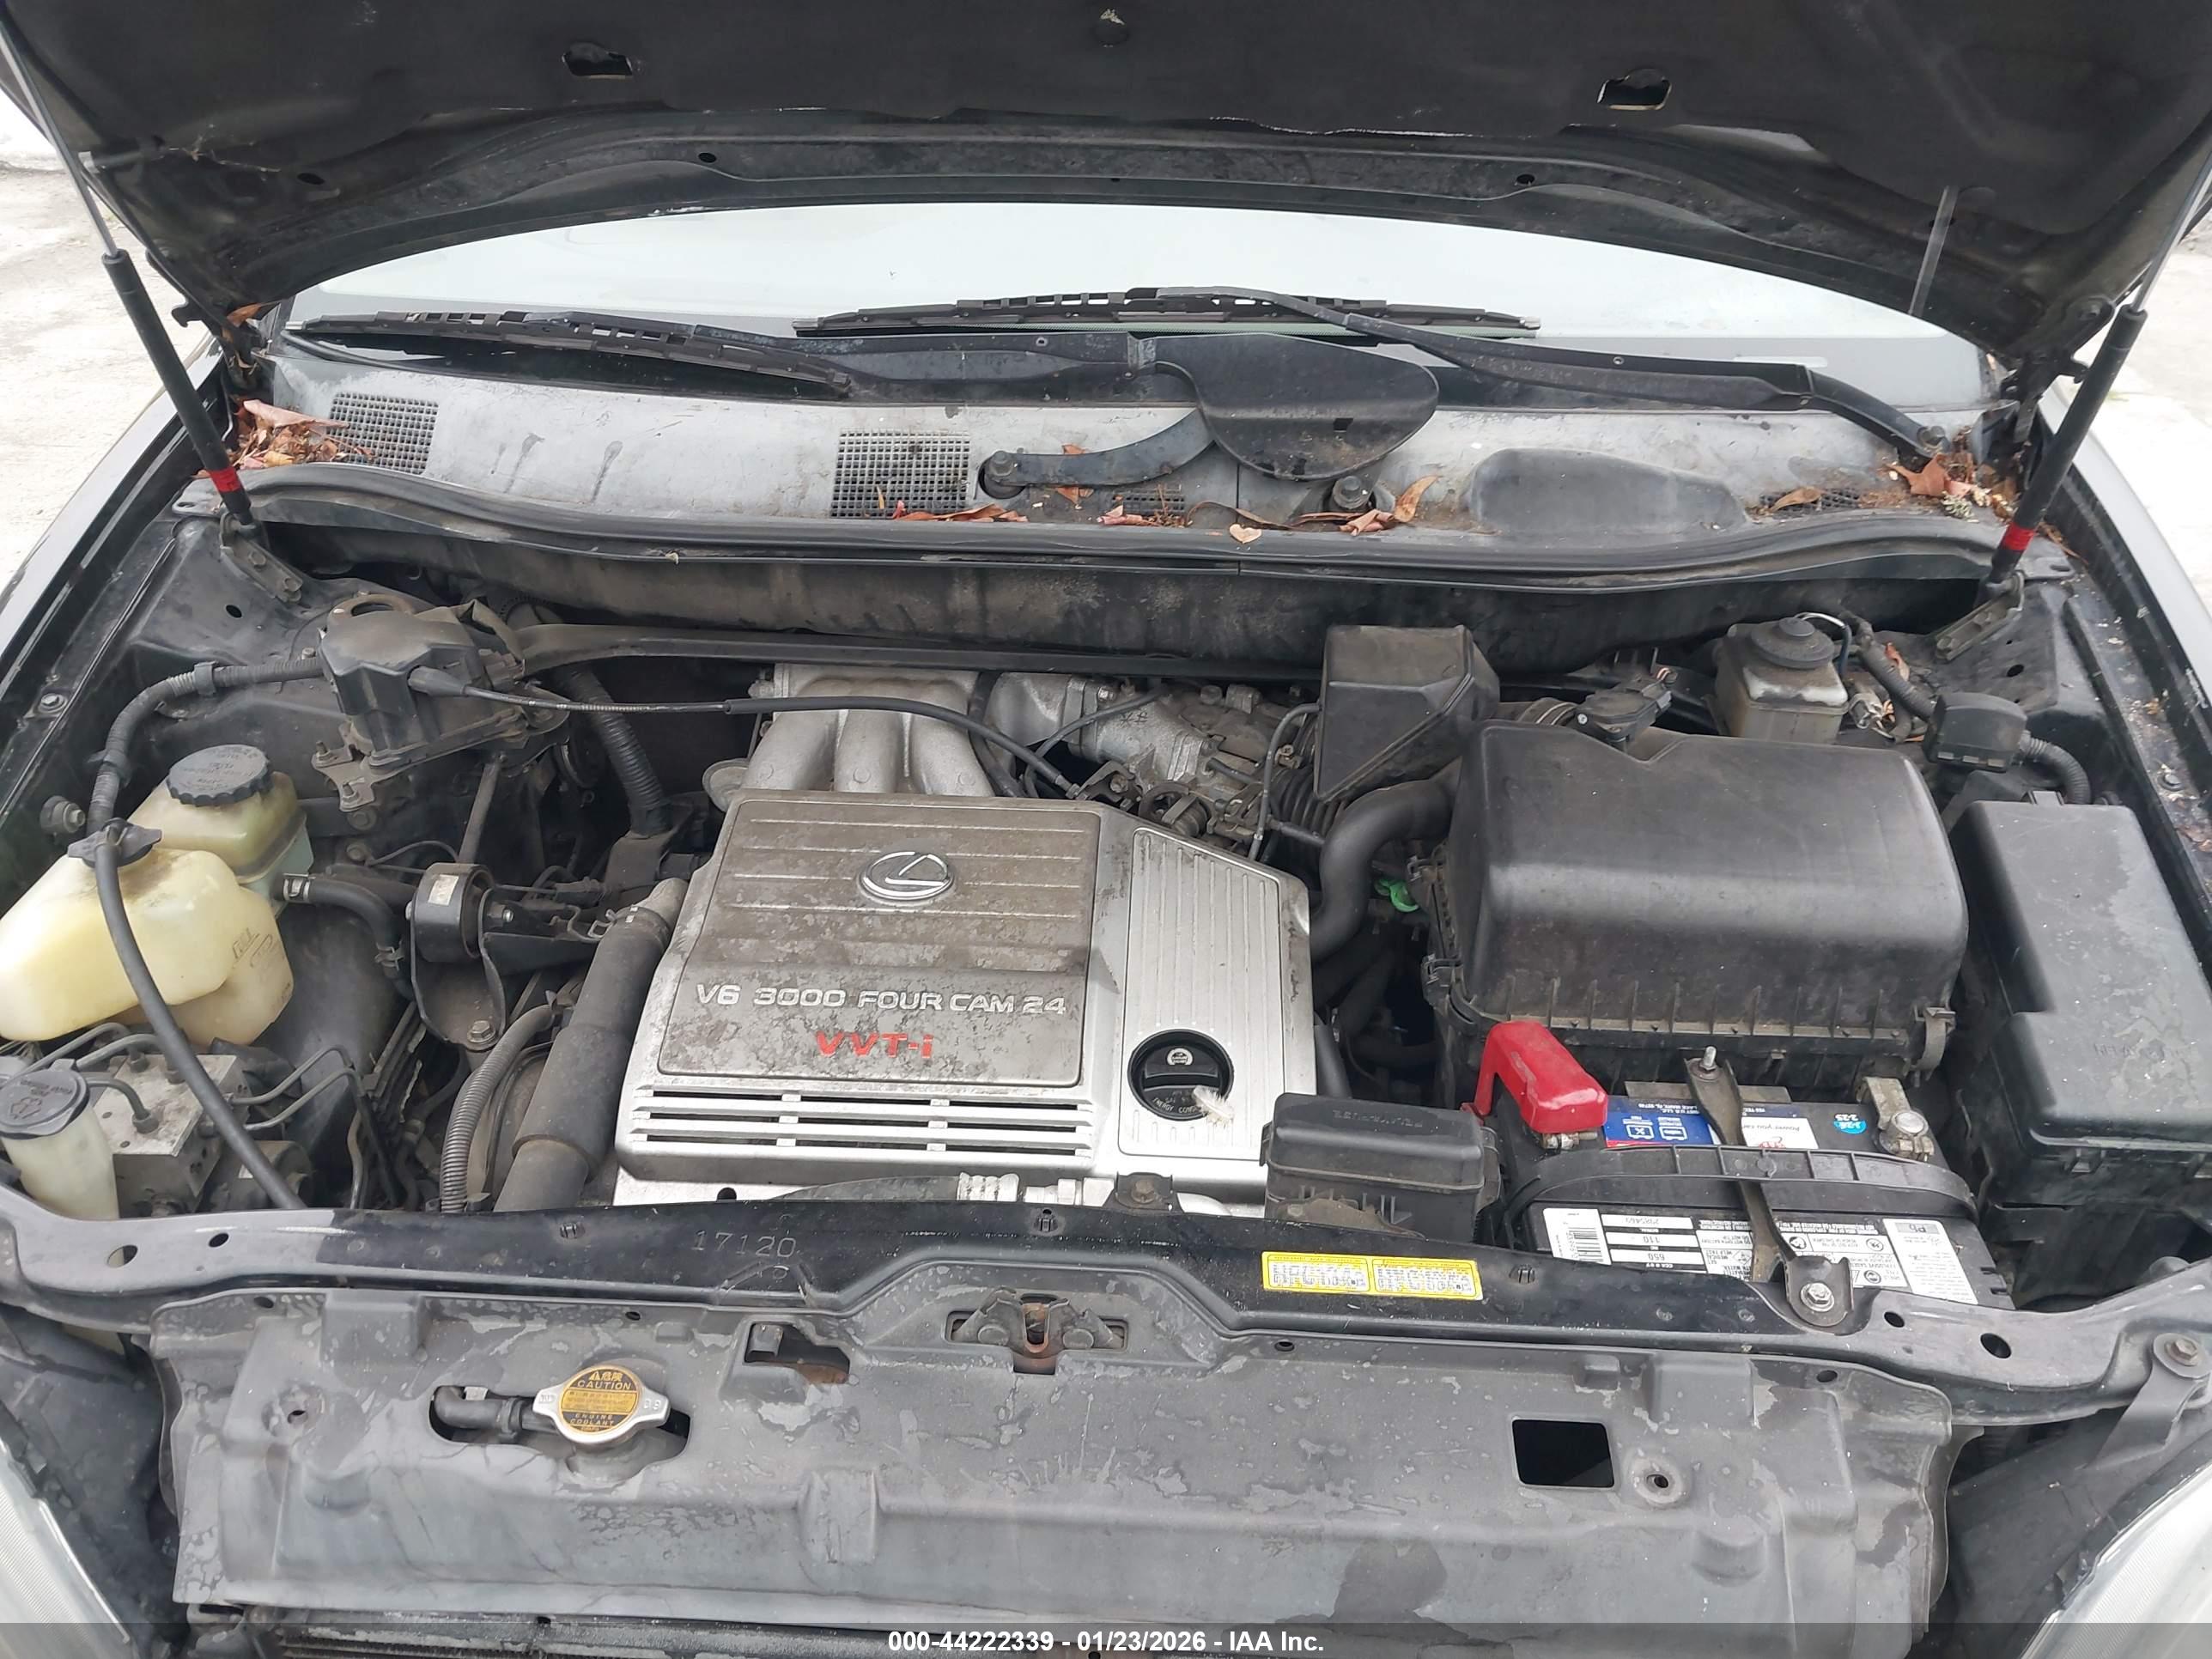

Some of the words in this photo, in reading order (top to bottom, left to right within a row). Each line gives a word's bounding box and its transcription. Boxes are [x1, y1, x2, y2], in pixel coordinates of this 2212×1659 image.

[696, 984, 741, 1005] V6
[754, 988, 846, 1007] 3000
[858, 990, 943, 1011] FOUR
[950, 994, 1015, 1013] CAM
[1022, 996, 1066, 1015] 24
[816, 1031, 934, 1059] VVT-i
[1909, 1224, 1927, 1233] Pb
[690, 1231, 797, 1258] 17120
[577, 1380, 632, 1390] CAUTION
[570, 1418, 615, 1426] COOLANT
